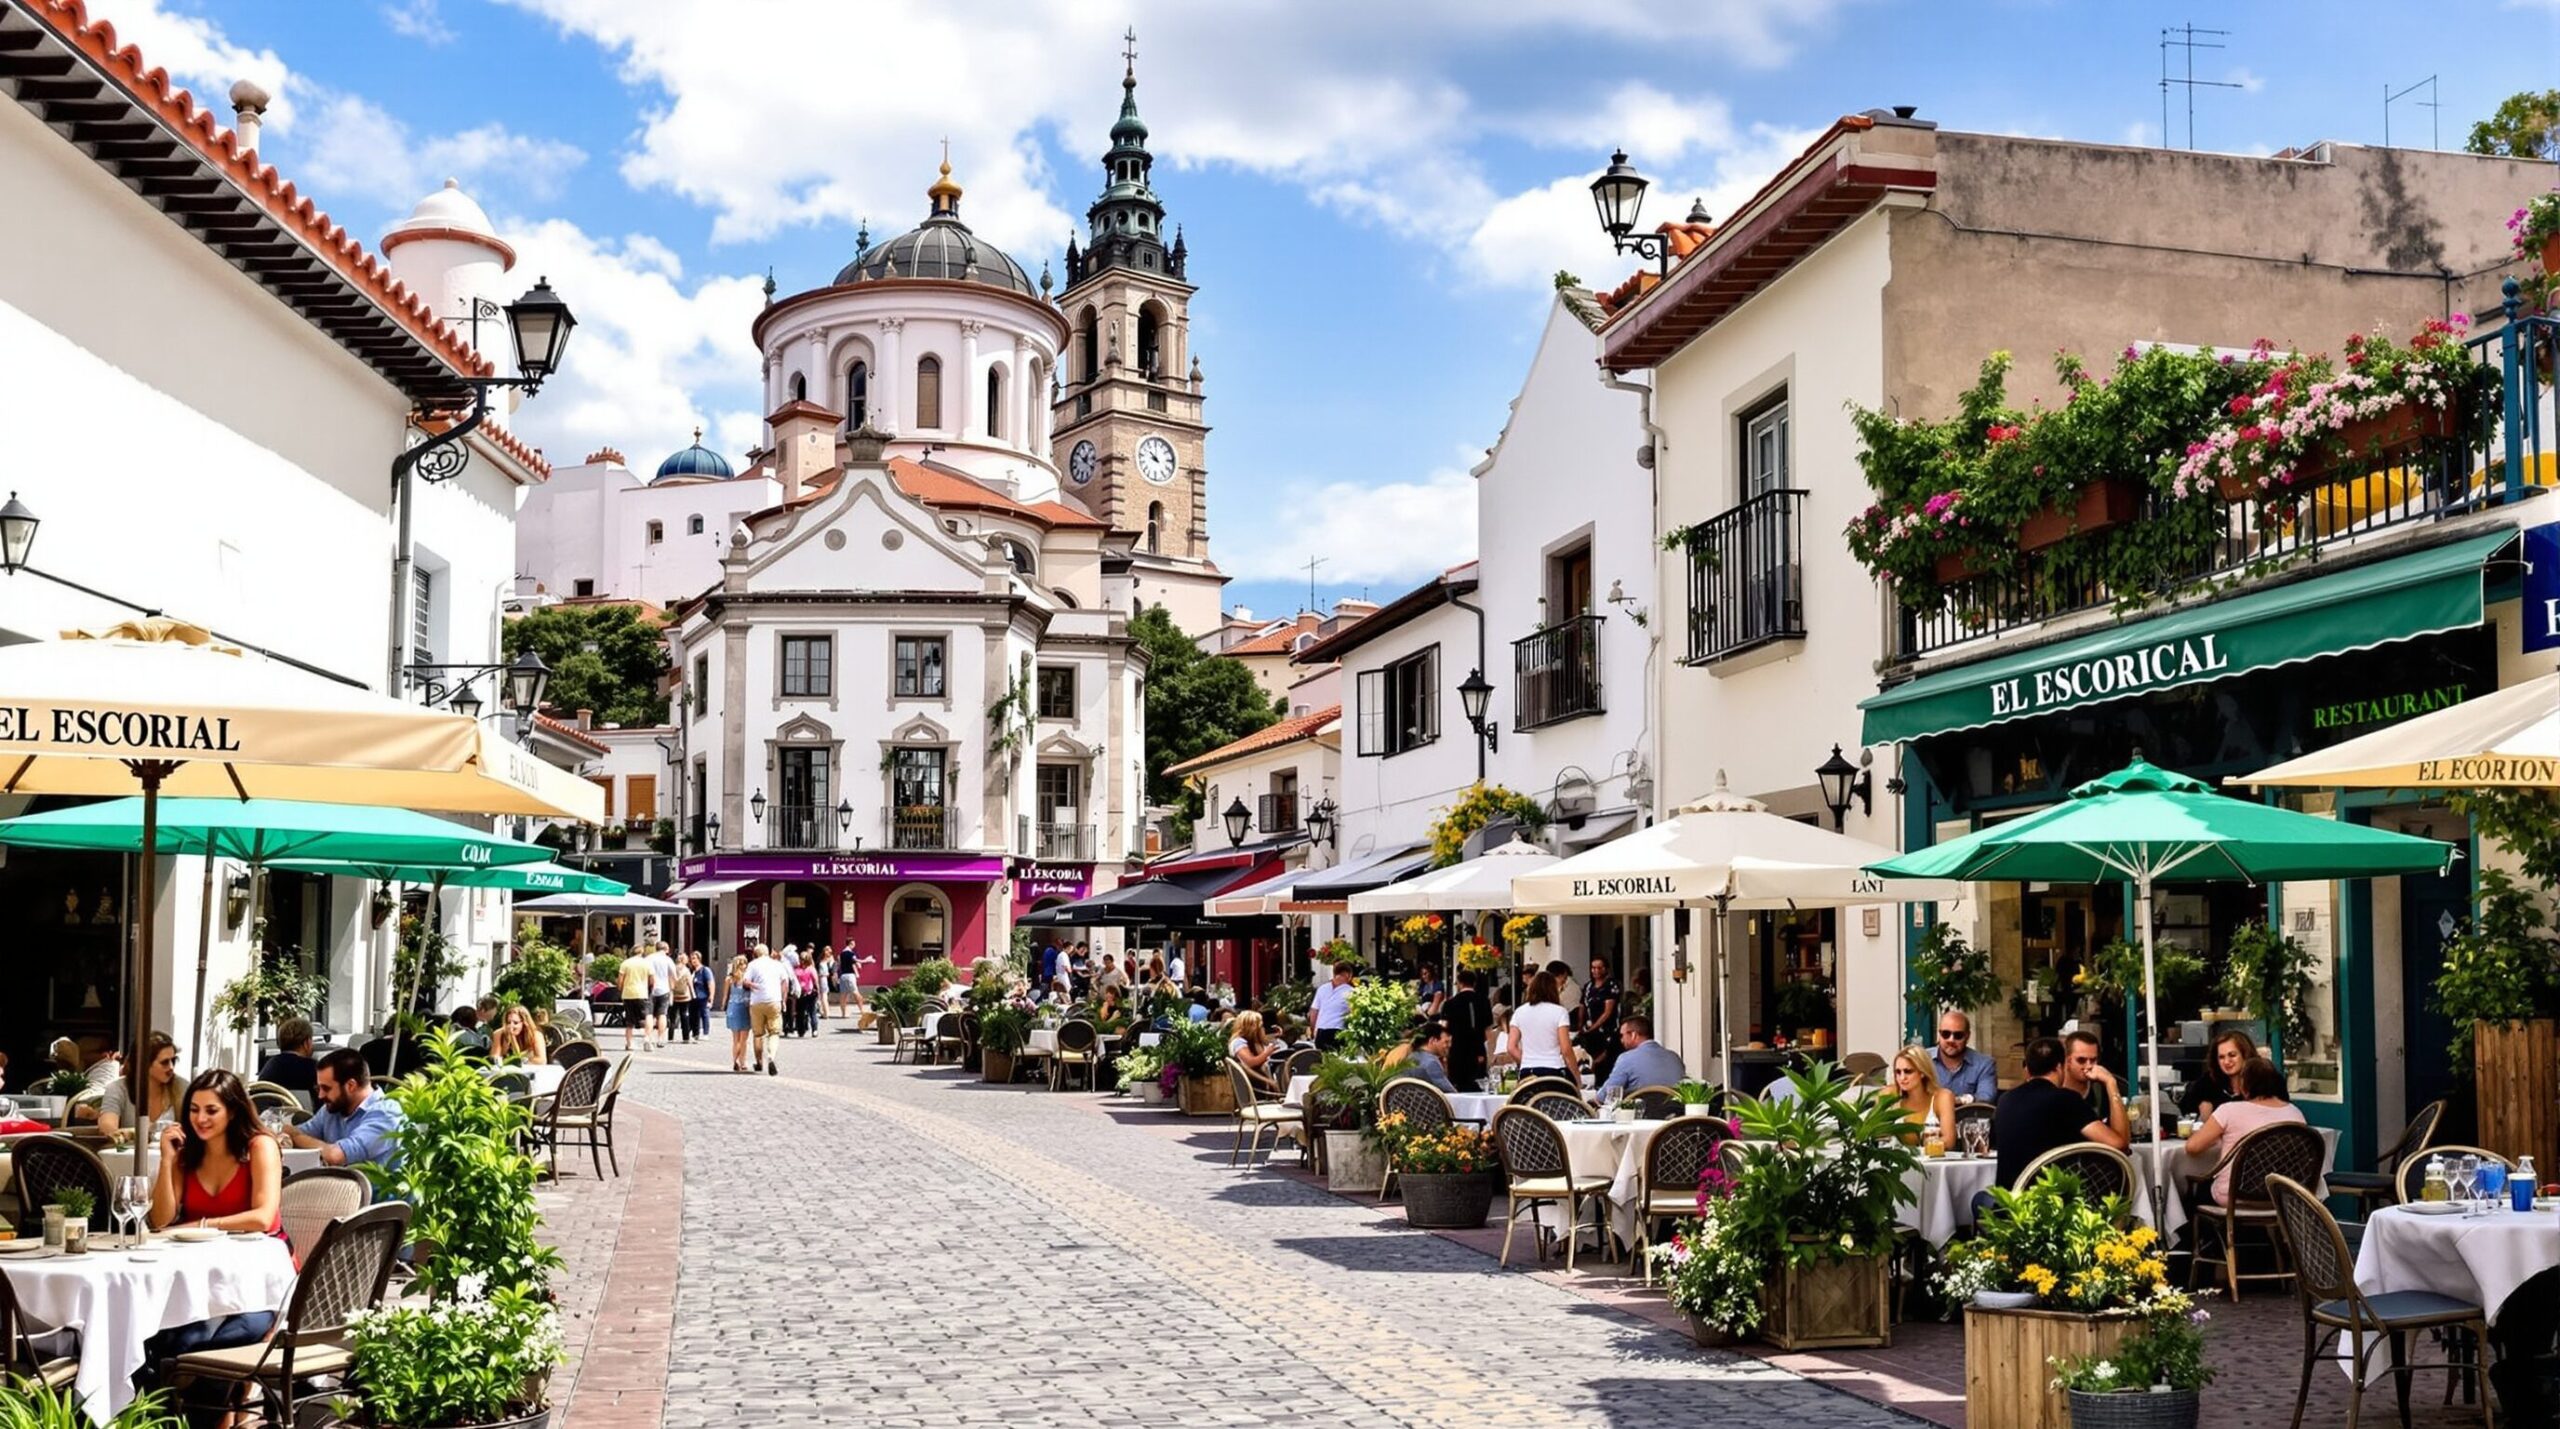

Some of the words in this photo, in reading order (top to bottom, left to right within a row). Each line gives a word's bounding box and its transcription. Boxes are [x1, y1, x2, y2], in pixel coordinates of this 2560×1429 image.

[1990, 679, 2029, 716] EL
[2034, 634, 2228, 706] ESCORICAL
[2313, 683, 2467, 728] RESTAURANT
[0, 706, 40, 742] EL
[51, 708, 240, 751] ESCORIAL
[2418, 761, 2445, 782] EL
[2450, 759, 2558, 782] ECORION
[812, 863, 829, 875] EL
[832, 863, 899, 876] ESCORIAL
[1573, 880, 1594, 896] EL
[1598, 876, 1676, 895] ESCORIAL
